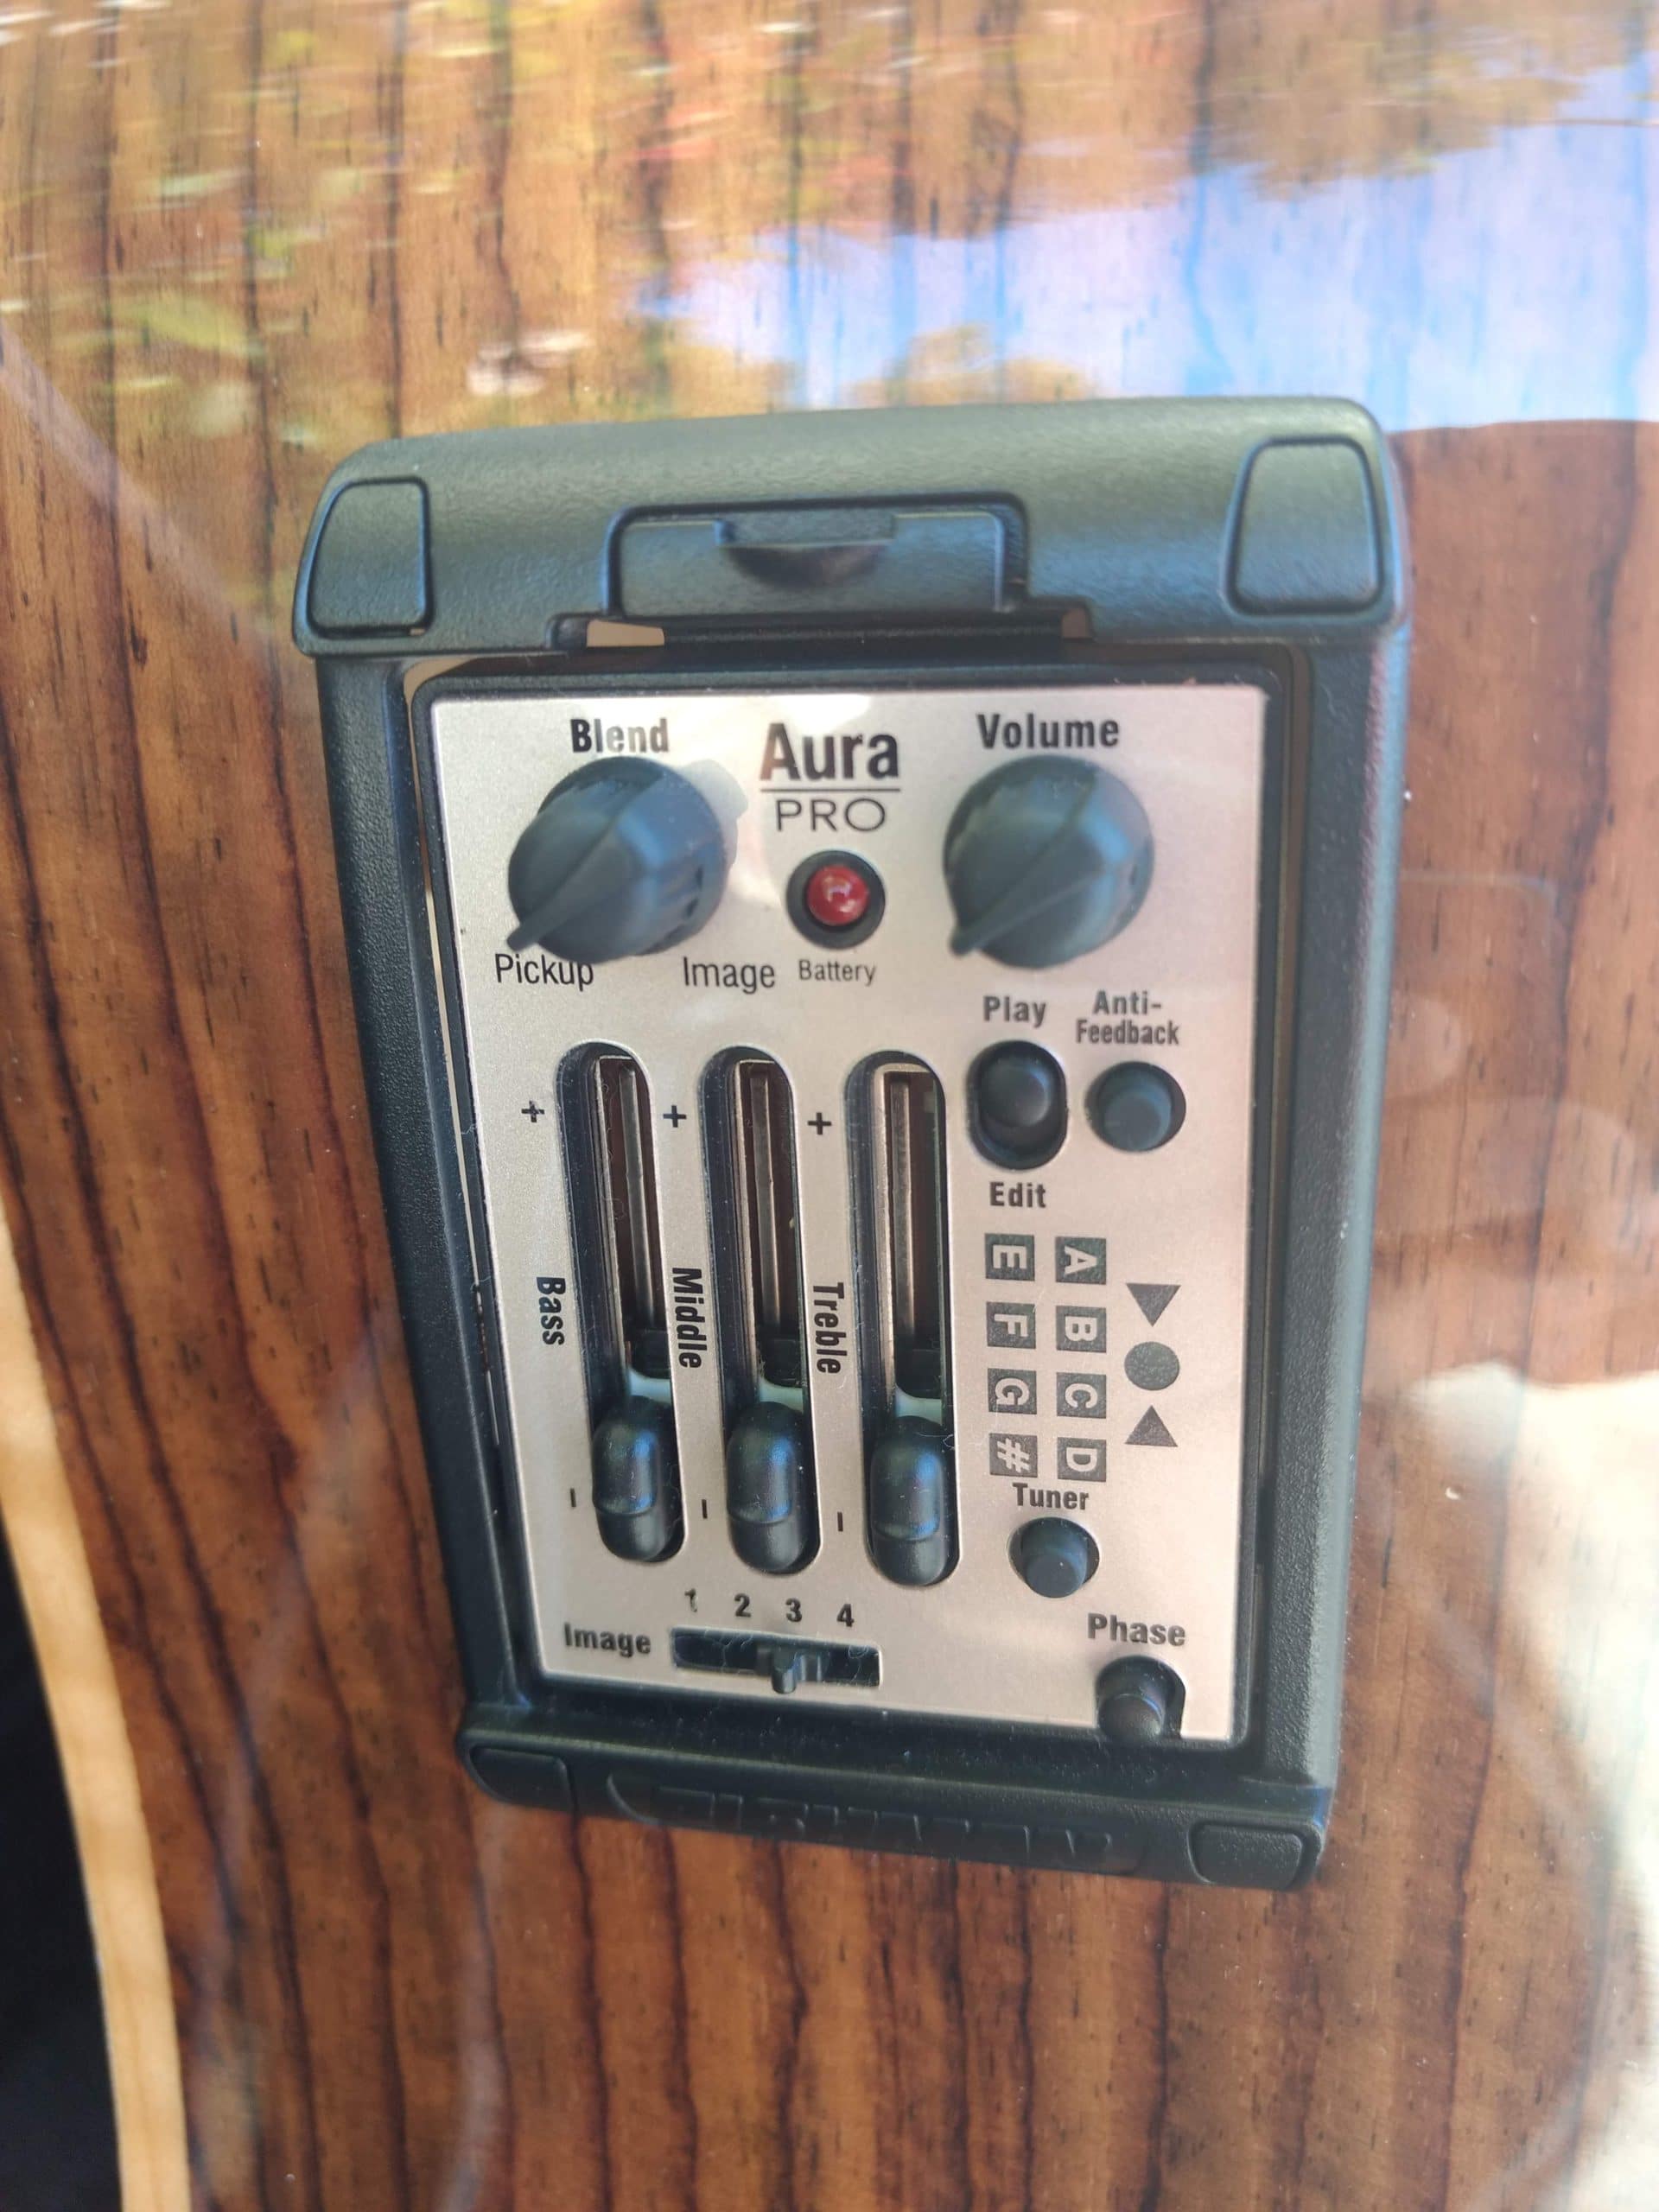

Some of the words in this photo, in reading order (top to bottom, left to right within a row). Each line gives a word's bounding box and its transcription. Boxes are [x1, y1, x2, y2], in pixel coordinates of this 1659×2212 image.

[570, 717, 670, 753] Blend
[976, 713, 1121, 750] Volume
[760, 722, 900, 781] Aura
[775, 798, 886, 832] PRO
[495, 952, 595, 992] Pickup
[683, 957, 776, 994] Image
[798, 958, 876, 986] Battery
[983, 995, 1046, 1027] Play
[1093, 990, 1163, 1015] Anti-
[1076, 1019, 1179, 1046] Feedback
[989, 1181, 1047, 1208] Edit
[992, 1244, 1027, 1270] E
[1065, 1245, 1098, 1275] A
[536, 1276, 567, 1346] Bass
[671, 1267, 708, 1369] Middle
[994, 1313, 1028, 1338] F
[812, 1281, 849, 1374] Treble
[1065, 1316, 1098, 1343] B
[994, 1376, 1030, 1406] G
[1065, 1382, 1098, 1409] C
[1065, 1447, 1098, 1472] D
[1012, 1483, 1090, 1510] Tuner
[684, 1587, 697, 1613] 1
[734, 1592, 752, 1618] 2
[785, 1598, 803, 1623] 3
[836, 1603, 855, 1628] 4
[563, 1622, 652, 1658] Image
[1087, 1613, 1186, 1648] Phase
